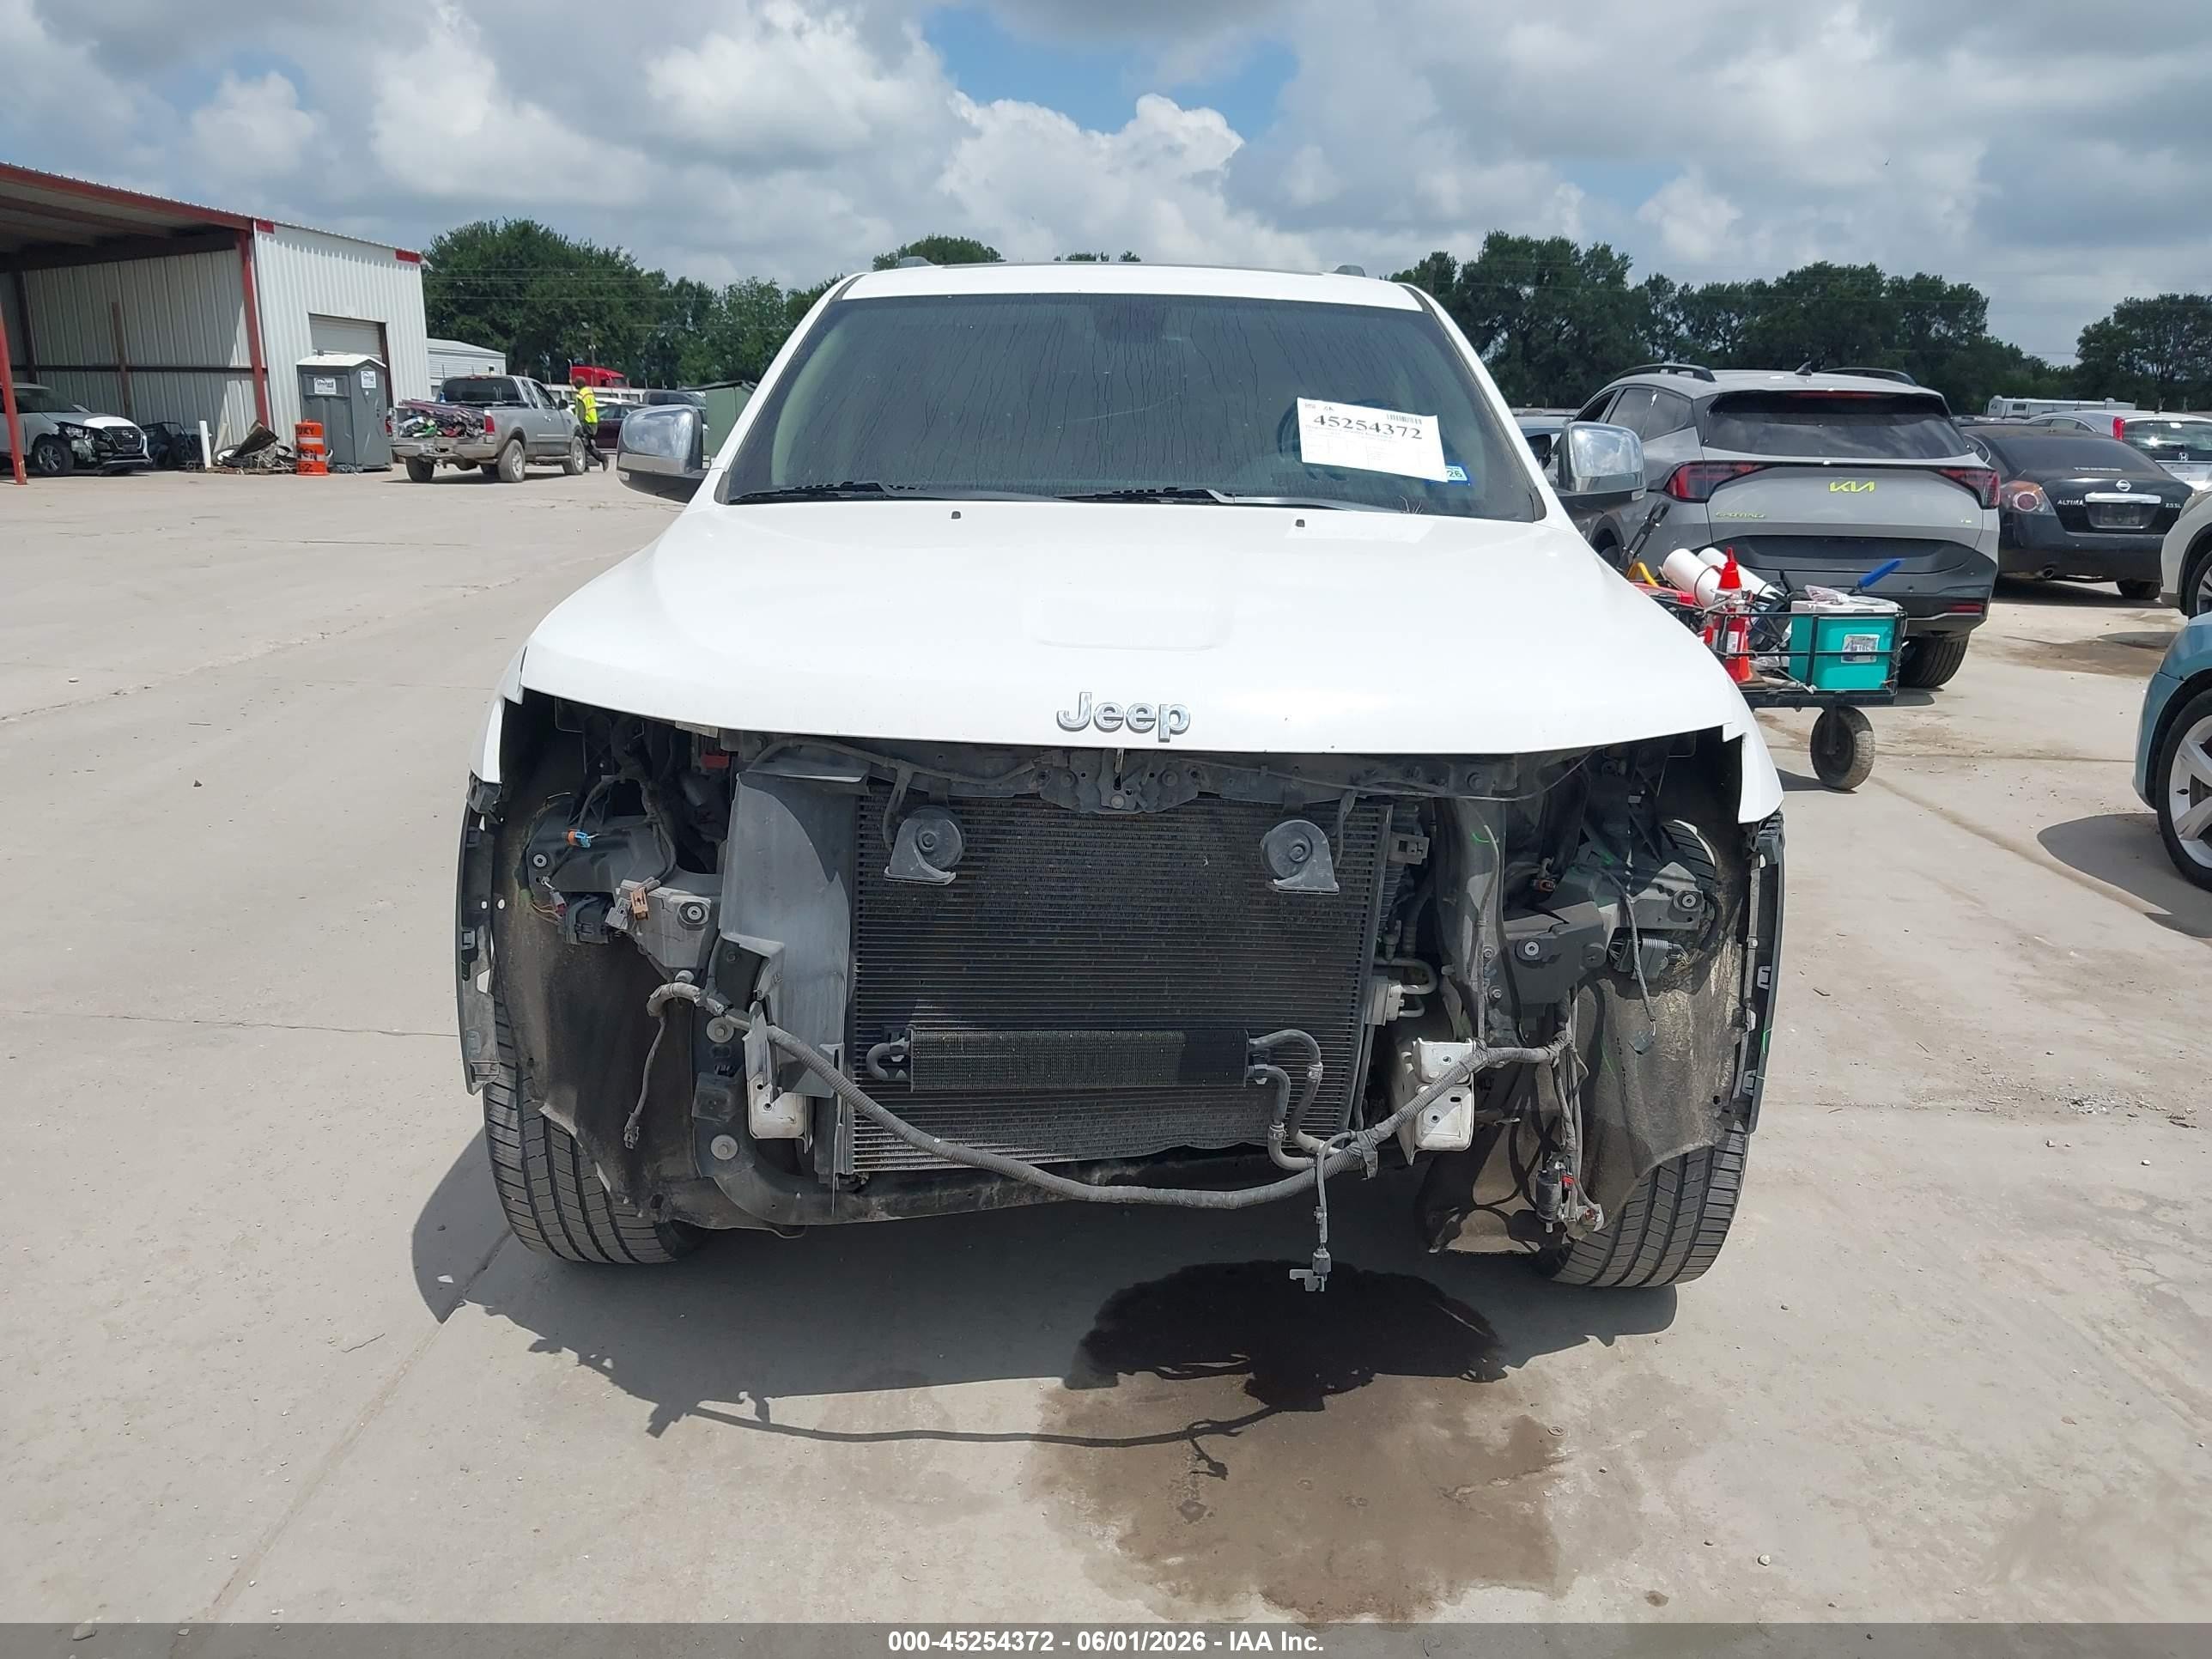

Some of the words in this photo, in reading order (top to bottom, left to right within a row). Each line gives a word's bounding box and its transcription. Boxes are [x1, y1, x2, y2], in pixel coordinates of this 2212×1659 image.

[1313, 415, 1423, 440] 45254372
[1829, 481, 1875, 493] KIA
[2057, 499, 2086, 507] ALTIMA
[1056, 691, 1190, 744] Jeep
